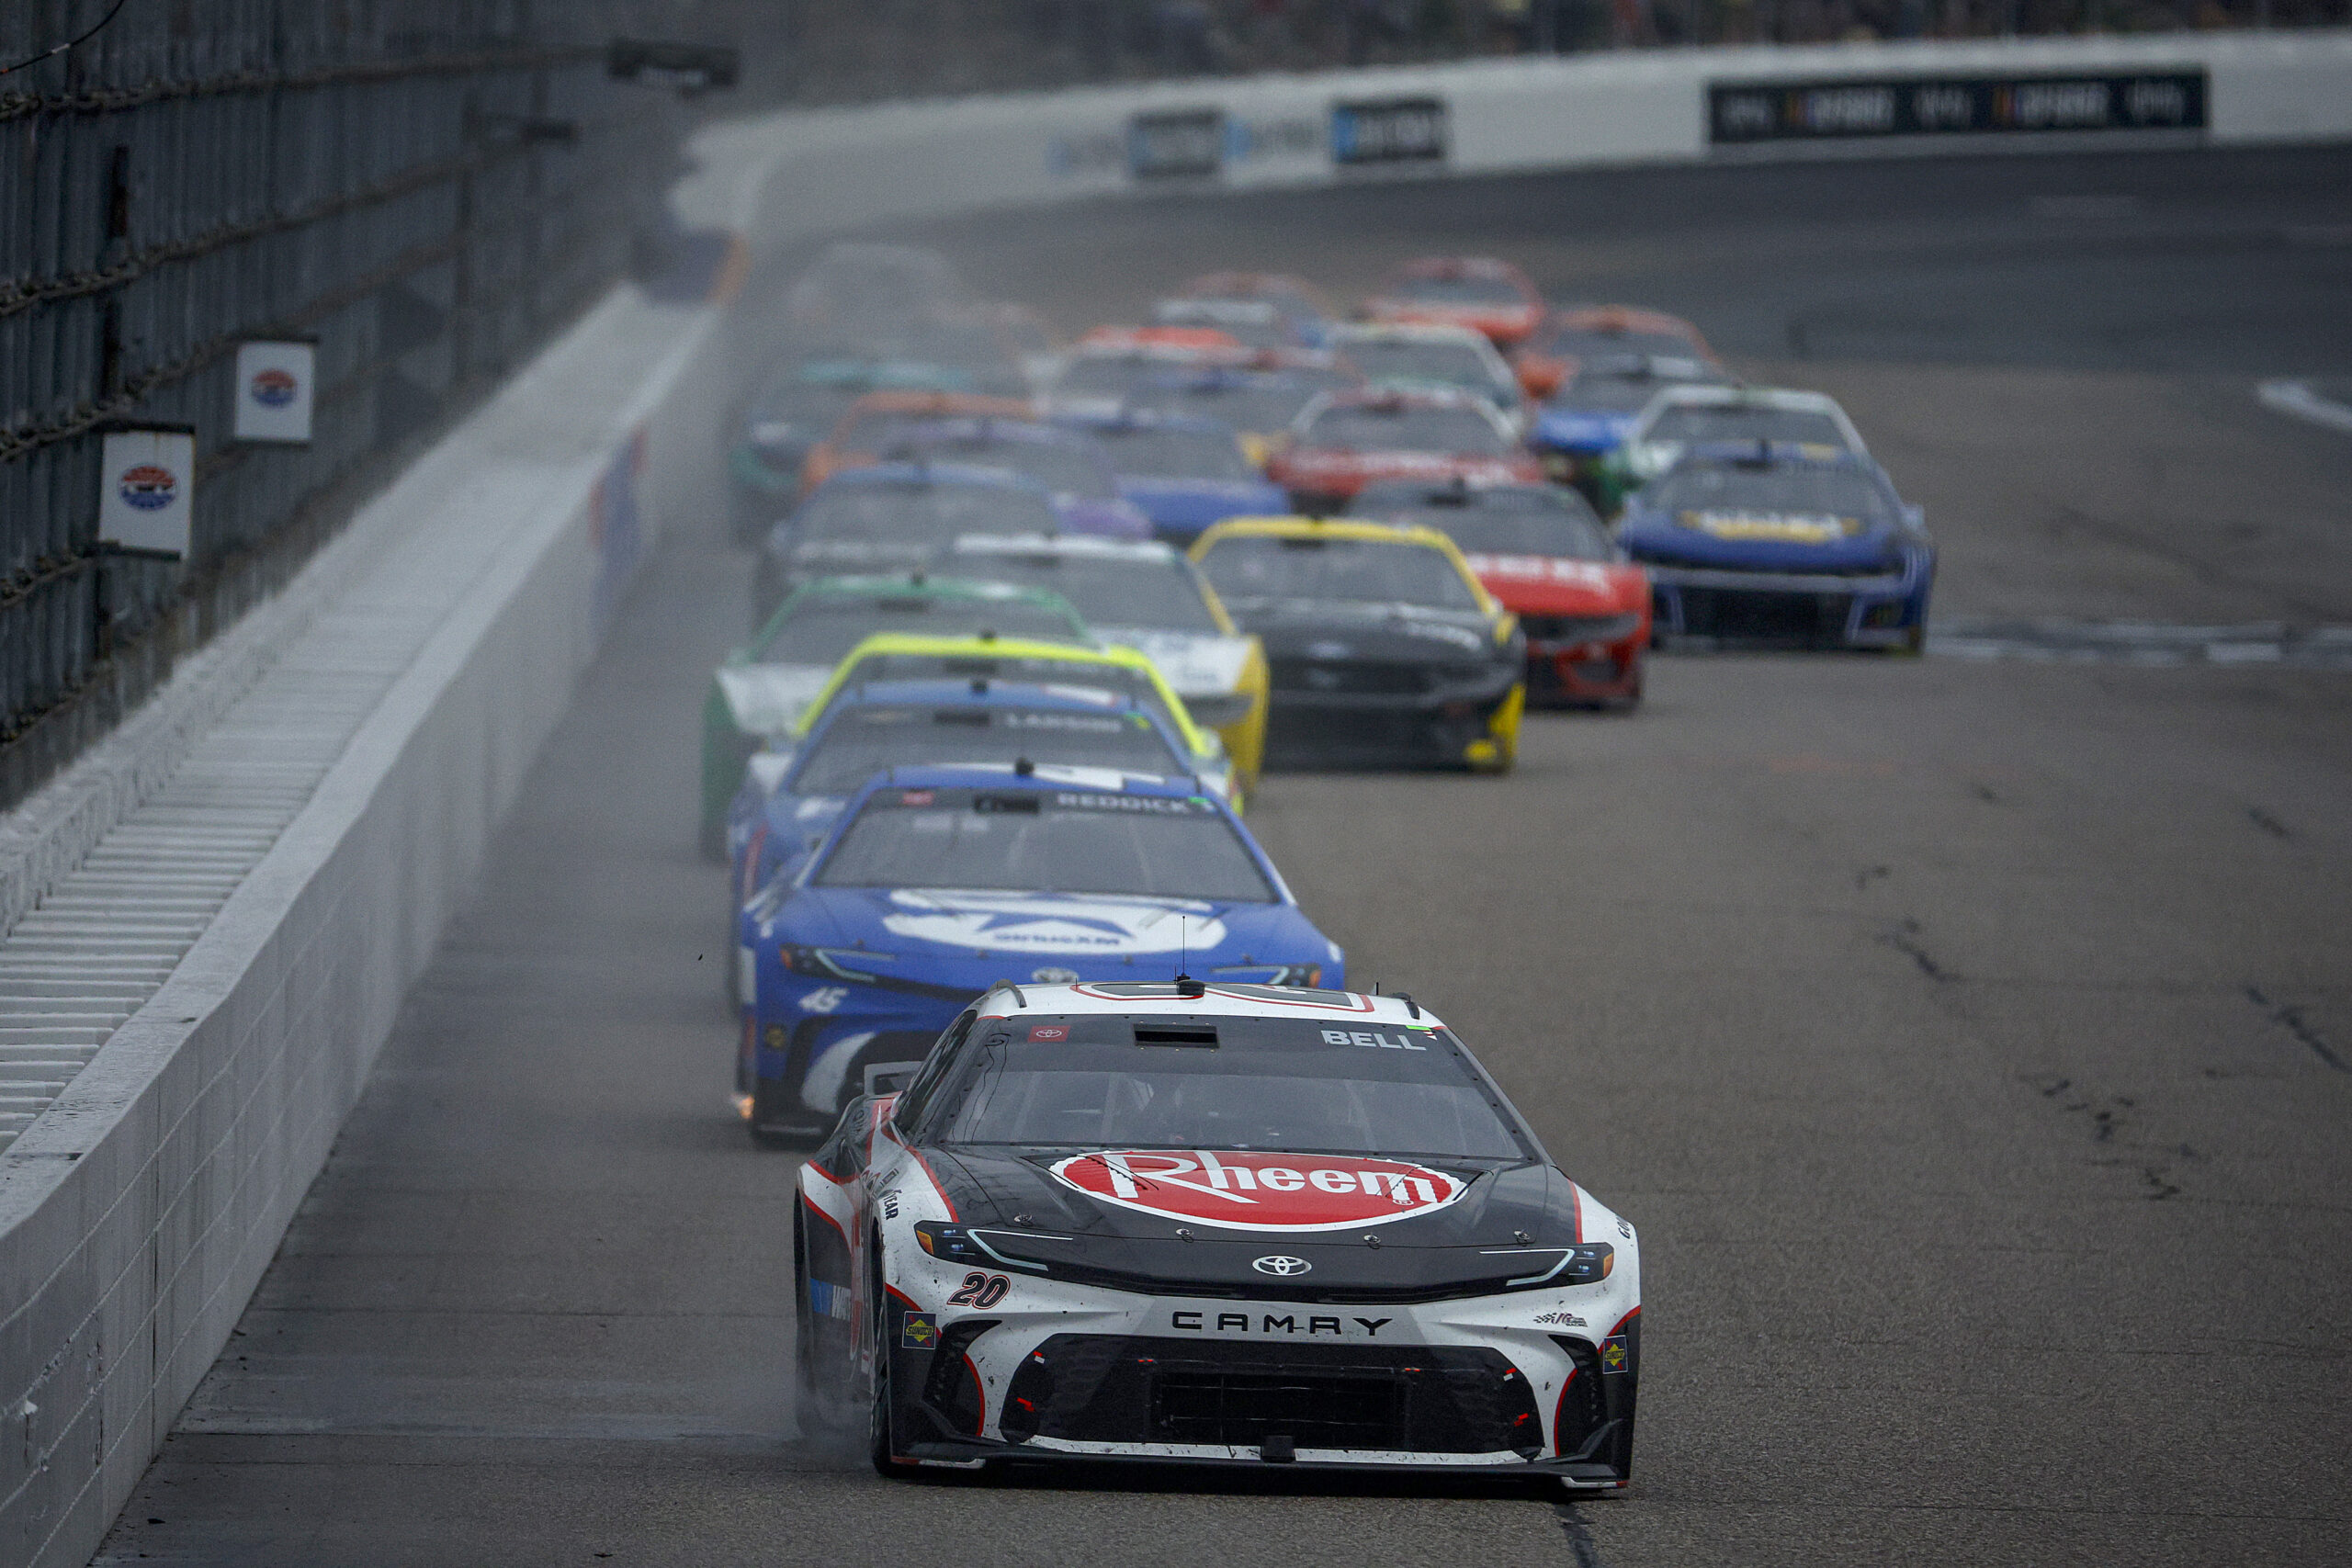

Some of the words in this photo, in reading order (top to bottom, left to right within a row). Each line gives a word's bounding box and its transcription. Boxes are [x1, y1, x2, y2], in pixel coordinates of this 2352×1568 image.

[1057, 793, 1189, 813] REDDICK
[797, 986, 850, 1013] 45
[1320, 1030, 1427, 1051] BELL
[1102, 1149, 1446, 1204] Rheem
[946, 1271, 1011, 1311] 20
[906, 1325, 935, 1337] SUNOCO
[1171, 1311, 1394, 1337] CAMRY
